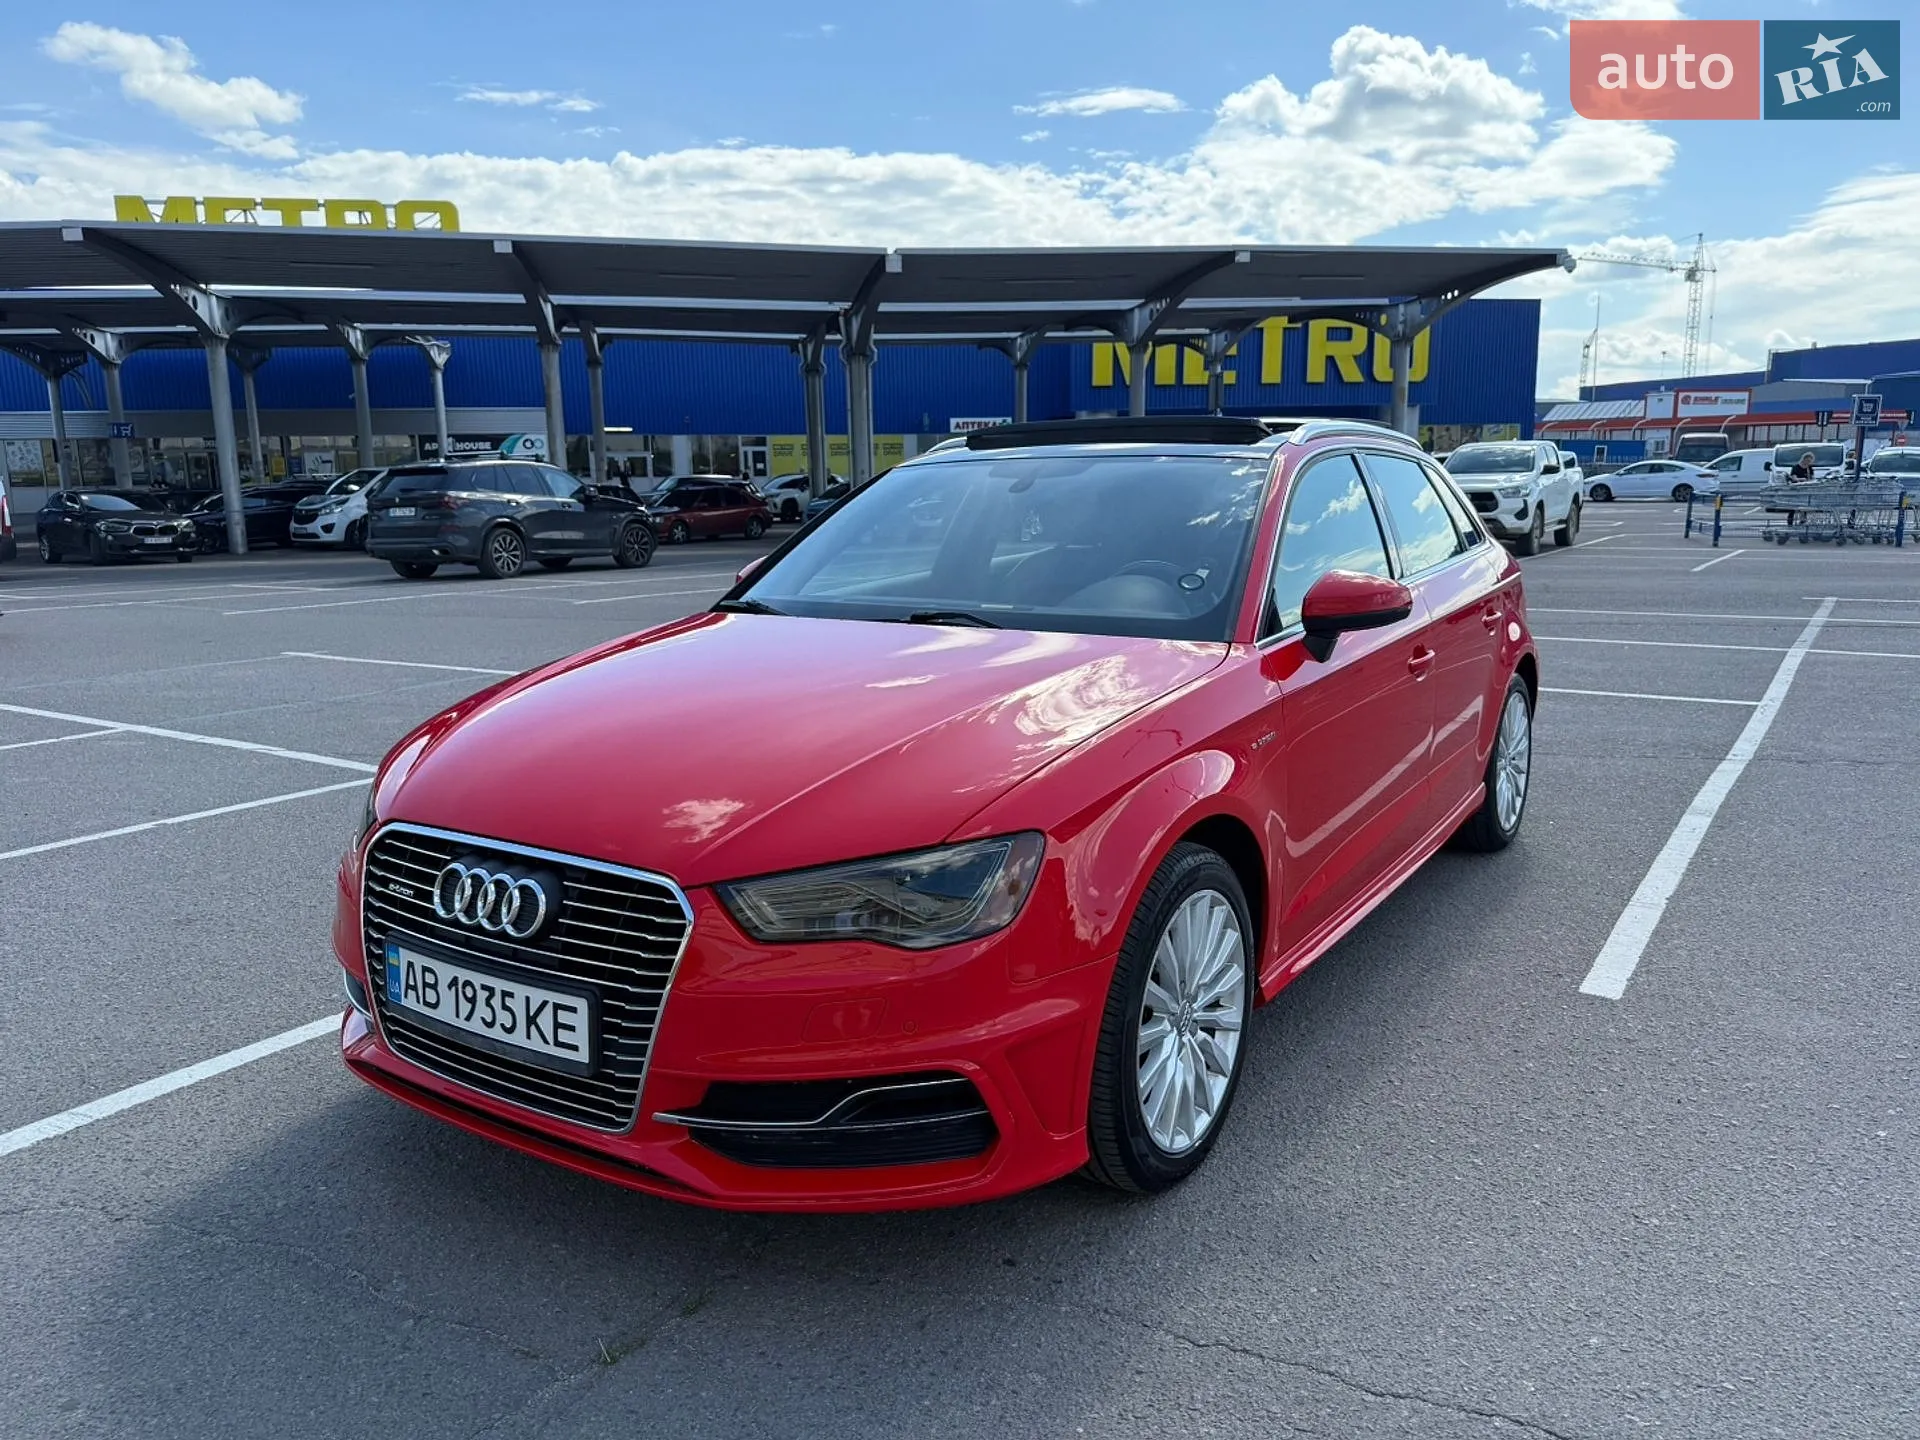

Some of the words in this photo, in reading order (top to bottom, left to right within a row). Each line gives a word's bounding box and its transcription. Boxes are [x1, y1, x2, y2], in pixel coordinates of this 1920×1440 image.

[404, 960, 441, 1010] AB
[447, 975, 517, 1035] 1935
[525, 995, 580, 1053] KE
